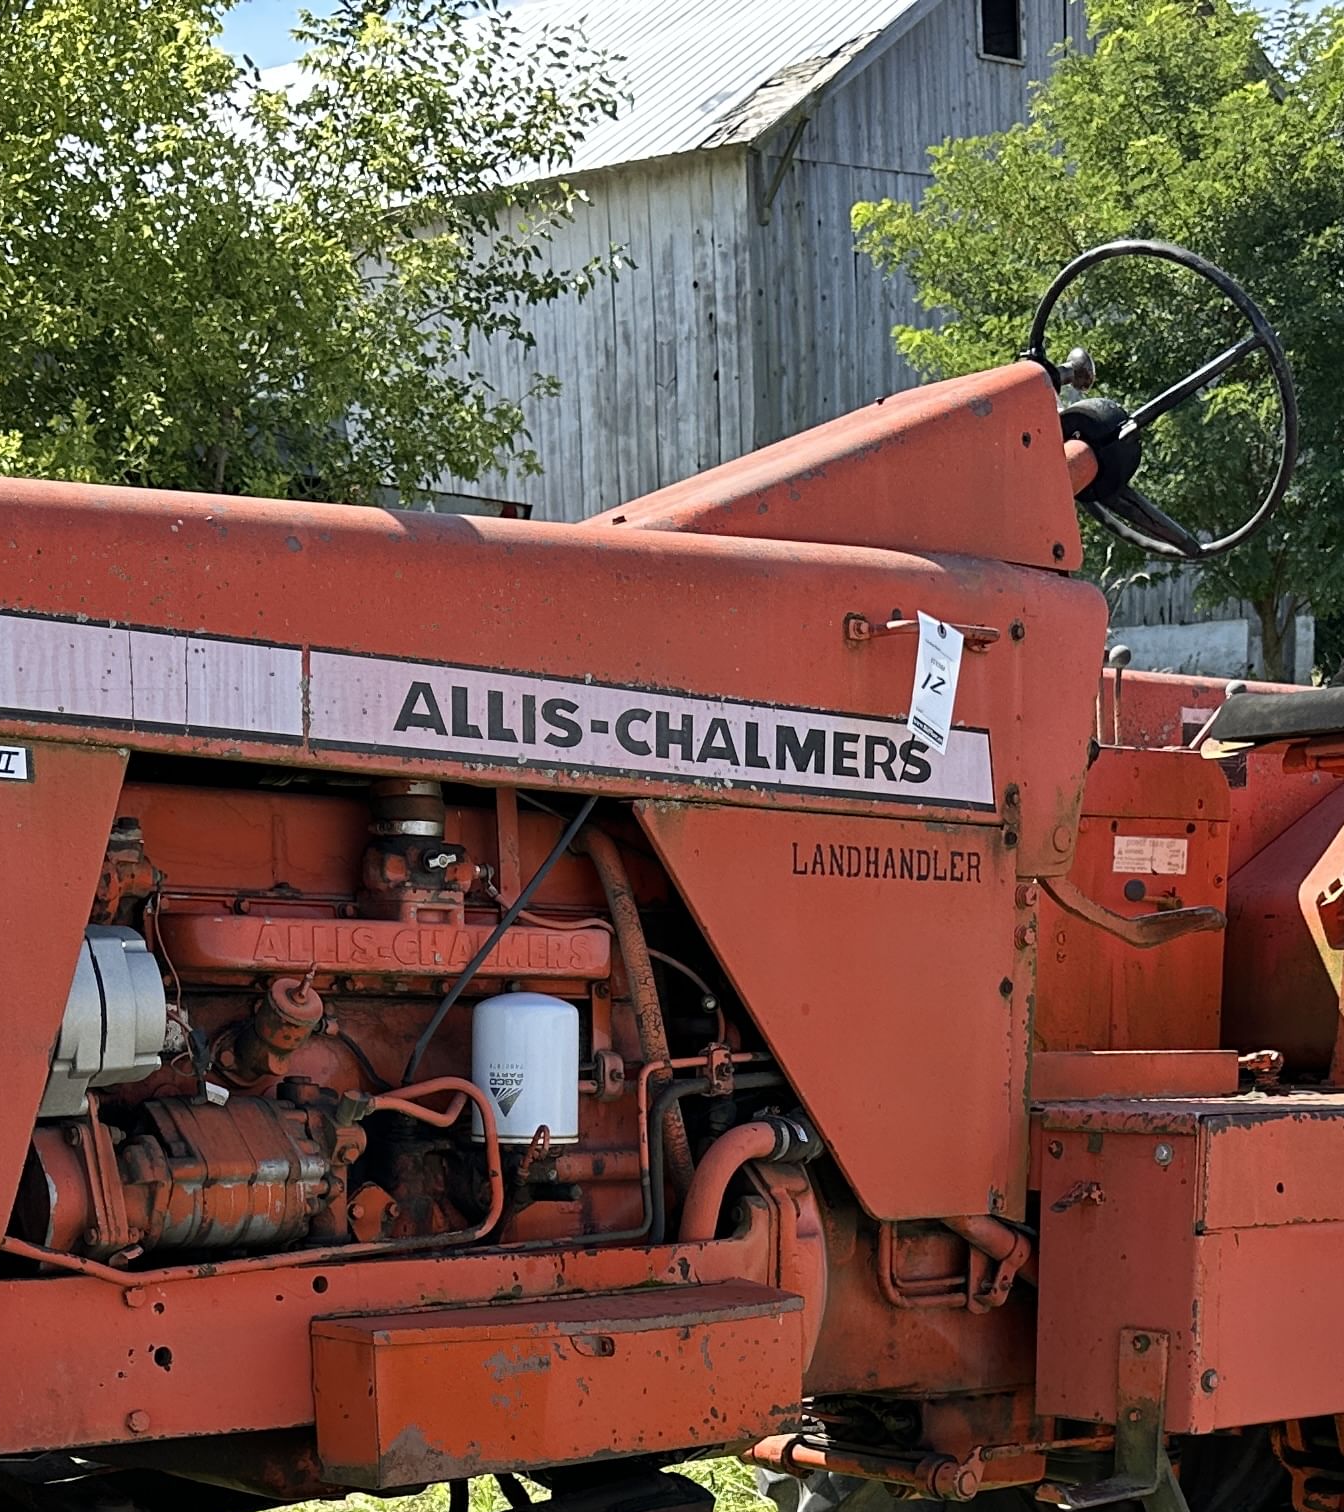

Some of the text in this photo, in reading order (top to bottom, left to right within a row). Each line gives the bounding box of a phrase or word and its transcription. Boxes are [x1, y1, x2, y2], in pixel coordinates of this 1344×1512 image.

[921, 672, 946, 696] 12
[393, 681, 932, 783] ALLIS-CHALMERS
[792, 842, 981, 883] LANDHANDLER
[253, 923, 592, 970] ALLIS-CHALMERS
[489, 1078, 523, 1086] AGCO
